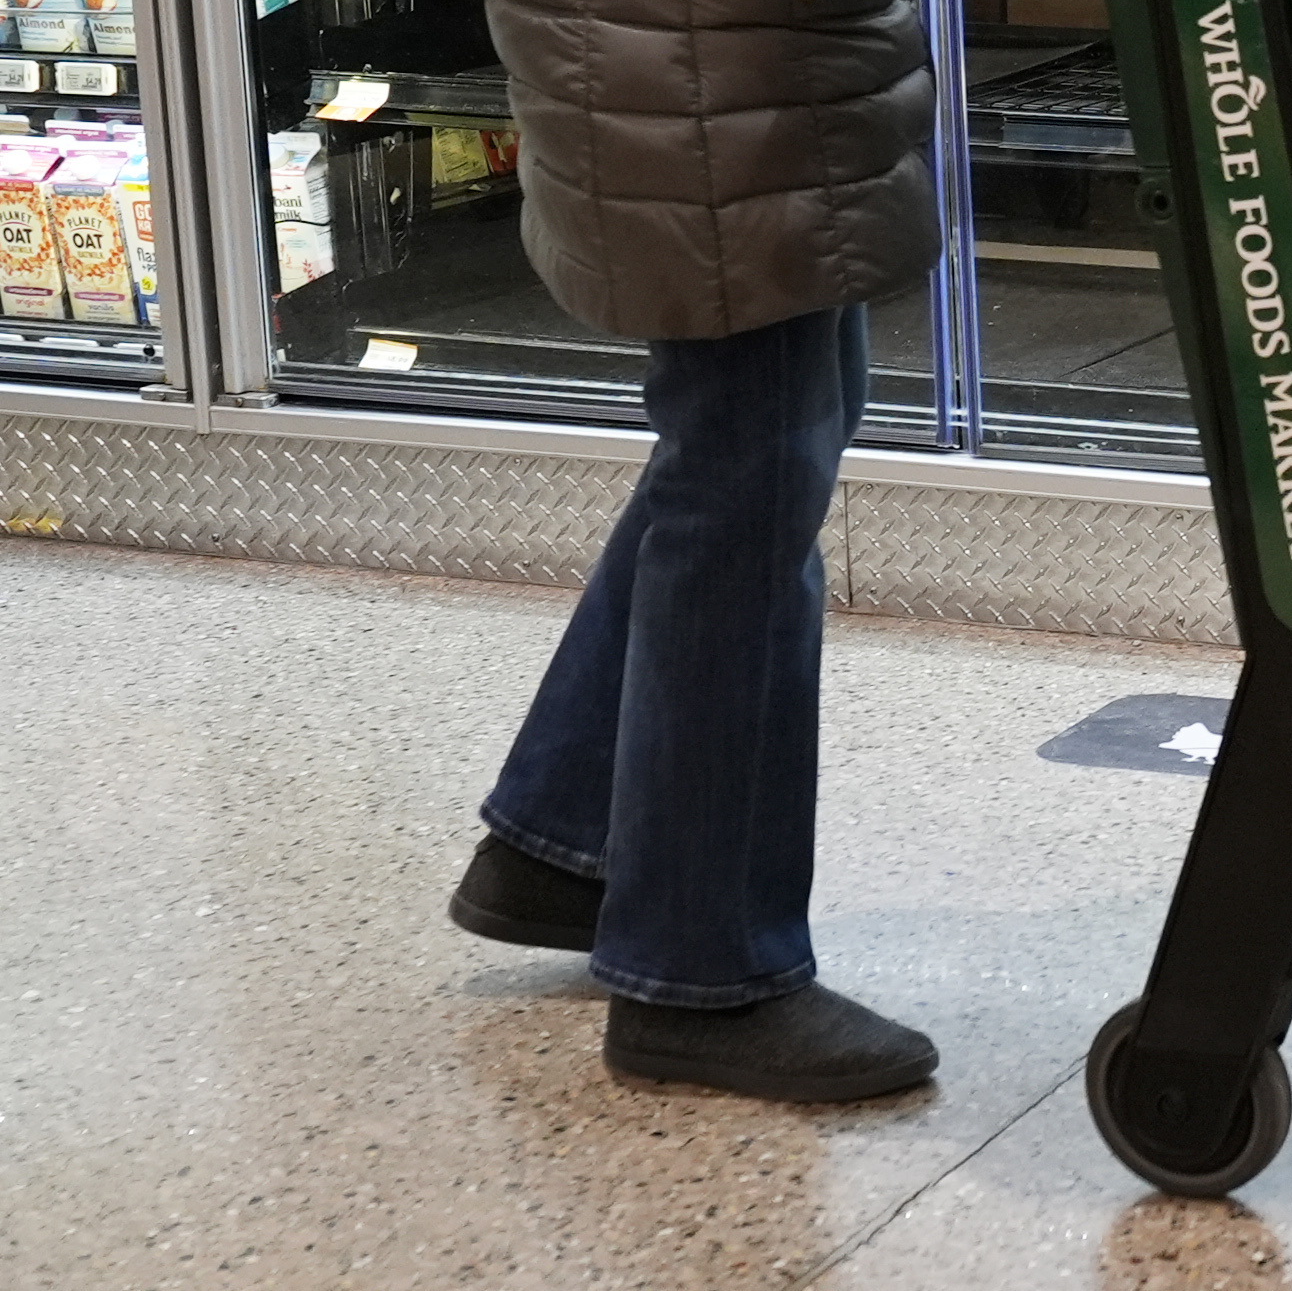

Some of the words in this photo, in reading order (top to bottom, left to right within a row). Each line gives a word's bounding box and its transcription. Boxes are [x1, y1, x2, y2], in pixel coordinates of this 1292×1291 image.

[18, 18, 65, 30] Almond
[1197, 0, 1266, 182] WHOLE
[67, 219, 102, 229] PLANET
[3, 228, 33, 244] OAT
[73, 233, 104, 249] OAT
[1229, 195, 1291, 358] FOODS
